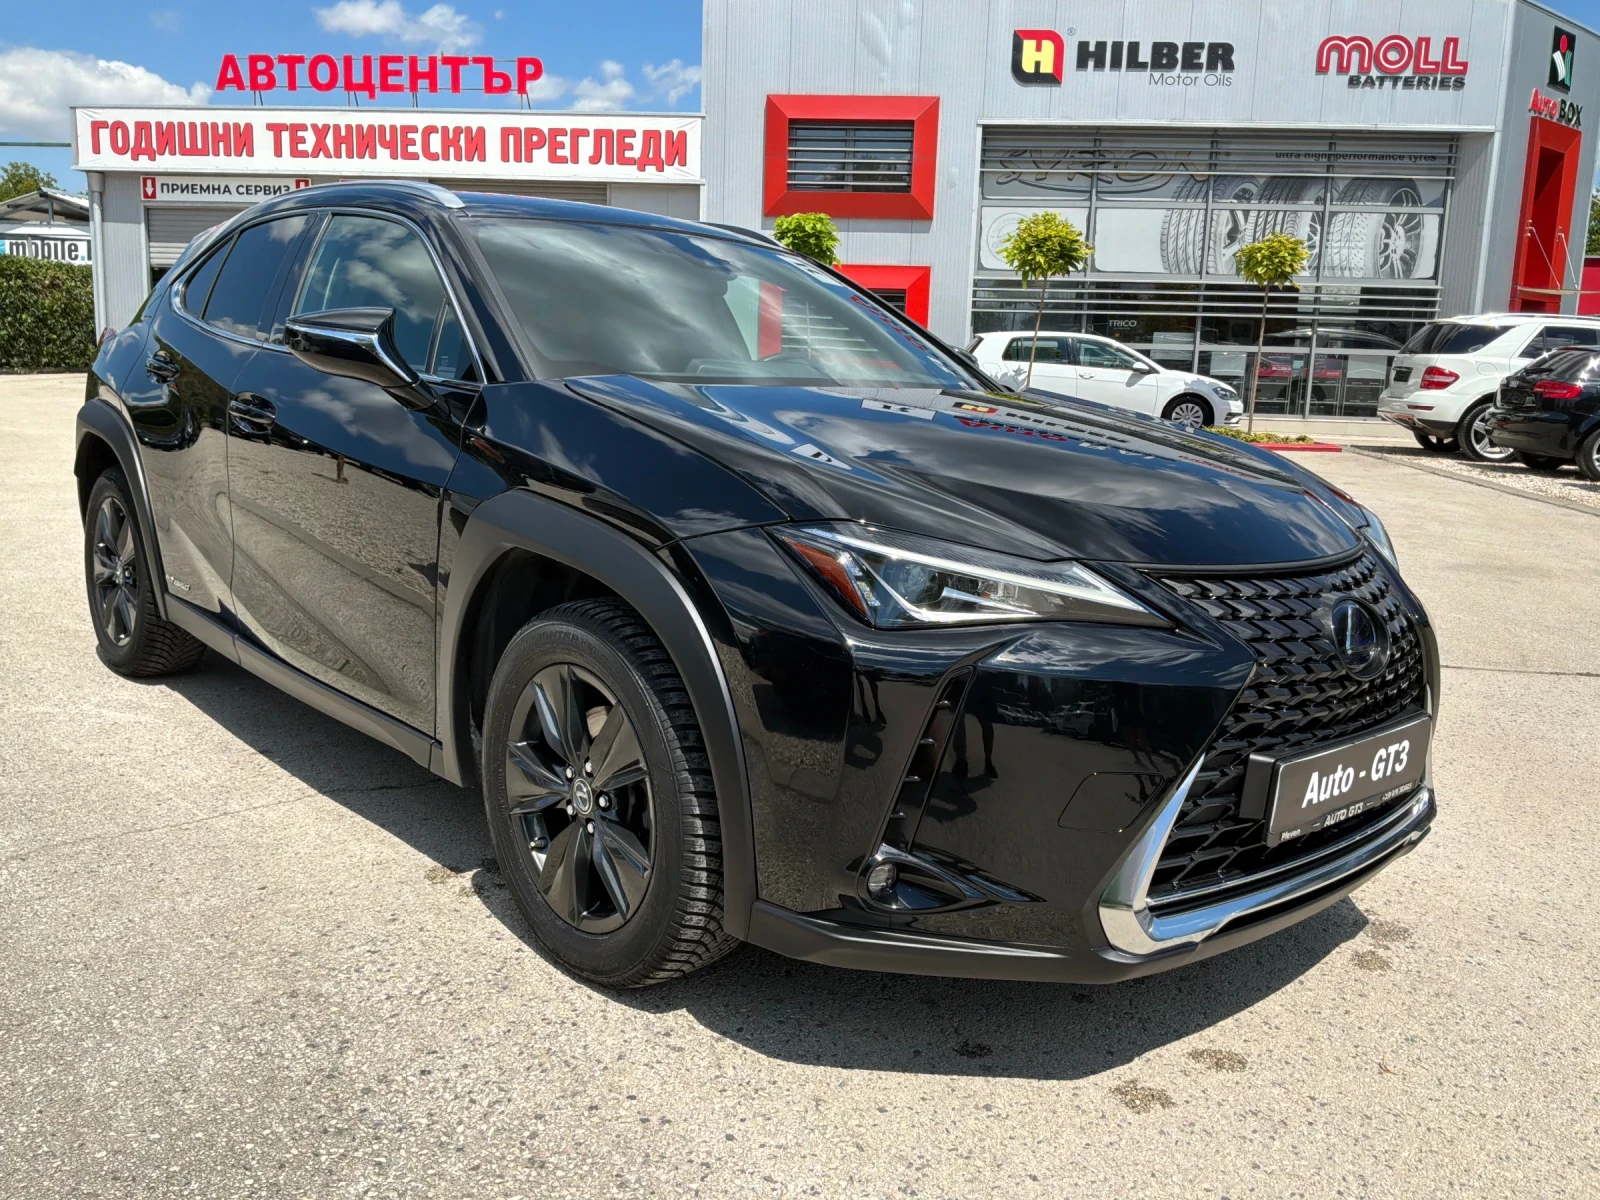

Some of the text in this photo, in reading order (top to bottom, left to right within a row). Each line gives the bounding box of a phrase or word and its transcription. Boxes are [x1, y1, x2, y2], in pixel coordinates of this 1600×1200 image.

[1076, 40, 1235, 73] HILBER
[1316, 34, 1469, 75] MOLL
[215, 53, 545, 101] АВТОЦЕНТЪР
[1149, 73, 1233, 87] Motor Oils
[1347, 75, 1466, 91] BATTERIES
[1557, 98, 1584, 128] BOX
[90, 120, 688, 173] ГОДИШНИ ТЕХНИЧЕСКИ ПРЕГЛЕДИ
[1408, 152, 1438, 163] tyres
[160, 182, 233, 196] ПРИЕМНА
[1109, 319, 1138, 328] TRICO
[1301, 764, 1354, 808] Auto
[1371, 740, 1410, 781] GT3
[1323, 802, 1365, 828] AUTO GT3
